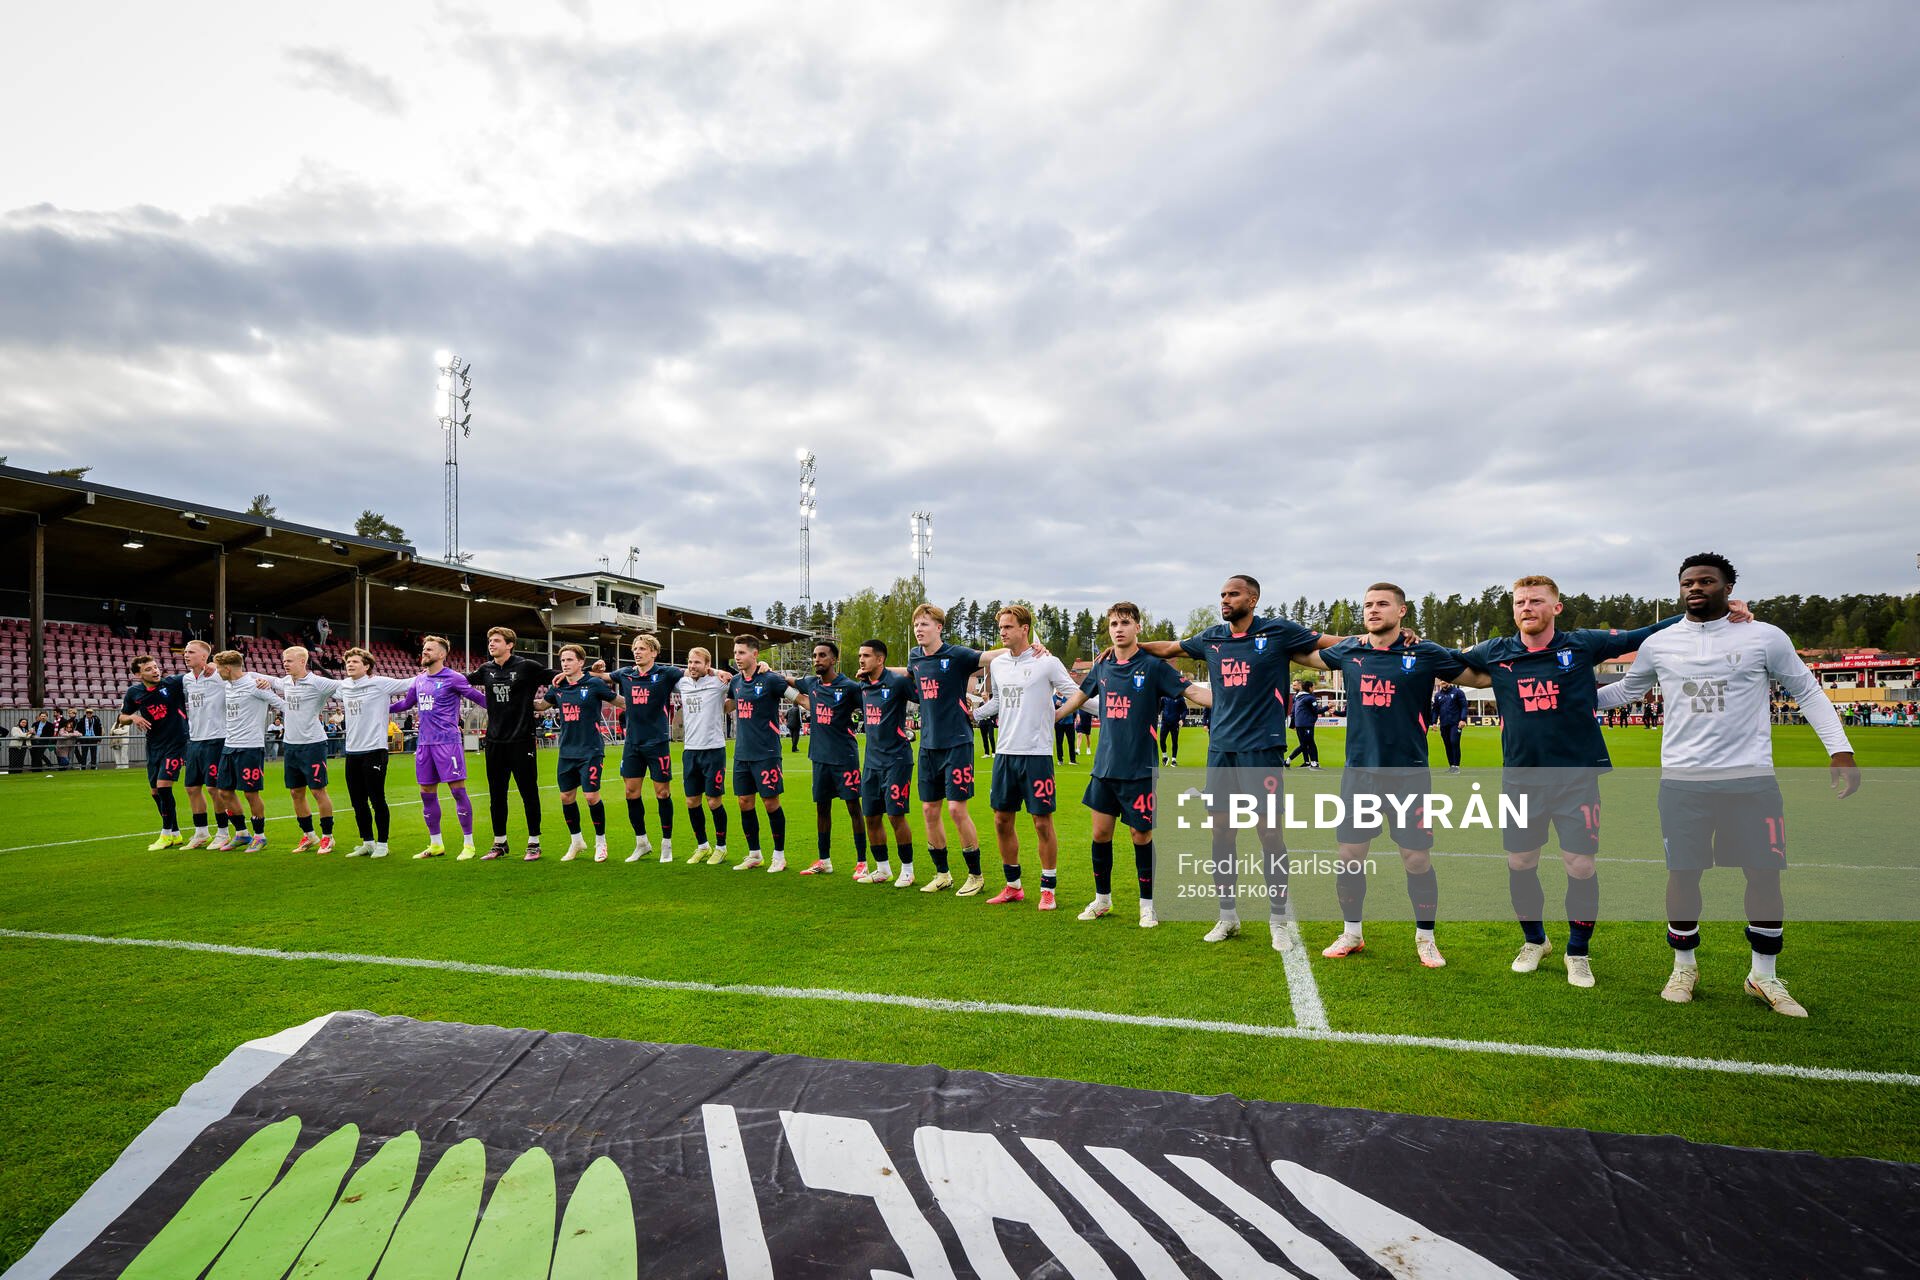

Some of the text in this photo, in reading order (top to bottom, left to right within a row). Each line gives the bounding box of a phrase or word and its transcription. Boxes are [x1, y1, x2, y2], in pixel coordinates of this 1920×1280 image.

[1360, 680, 1396, 694] MAL-
[1518, 680, 1560, 698] MAL-
[1006, 698, 1020, 708] LY!
[1691, 697, 1725, 713] LY!
[165, 758, 179, 771] 19
[311, 763, 321, 777] 7
[451, 756, 458, 769] 1
[658, 756, 670, 770] 17
[242, 768, 260, 781] 38
[589, 766, 598, 780] 2
[715, 770, 723, 784] 6
[760, 769, 779, 785] 23
[843, 770, 861, 786] 22
[952, 767, 972, 785] 35
[890, 783, 909, 799] 34
[1033, 778, 1054, 798] 20
[1132, 792, 1157, 813] 40
[1579, 803, 1601, 829] 10
[1764, 816, 1785, 845] 11
